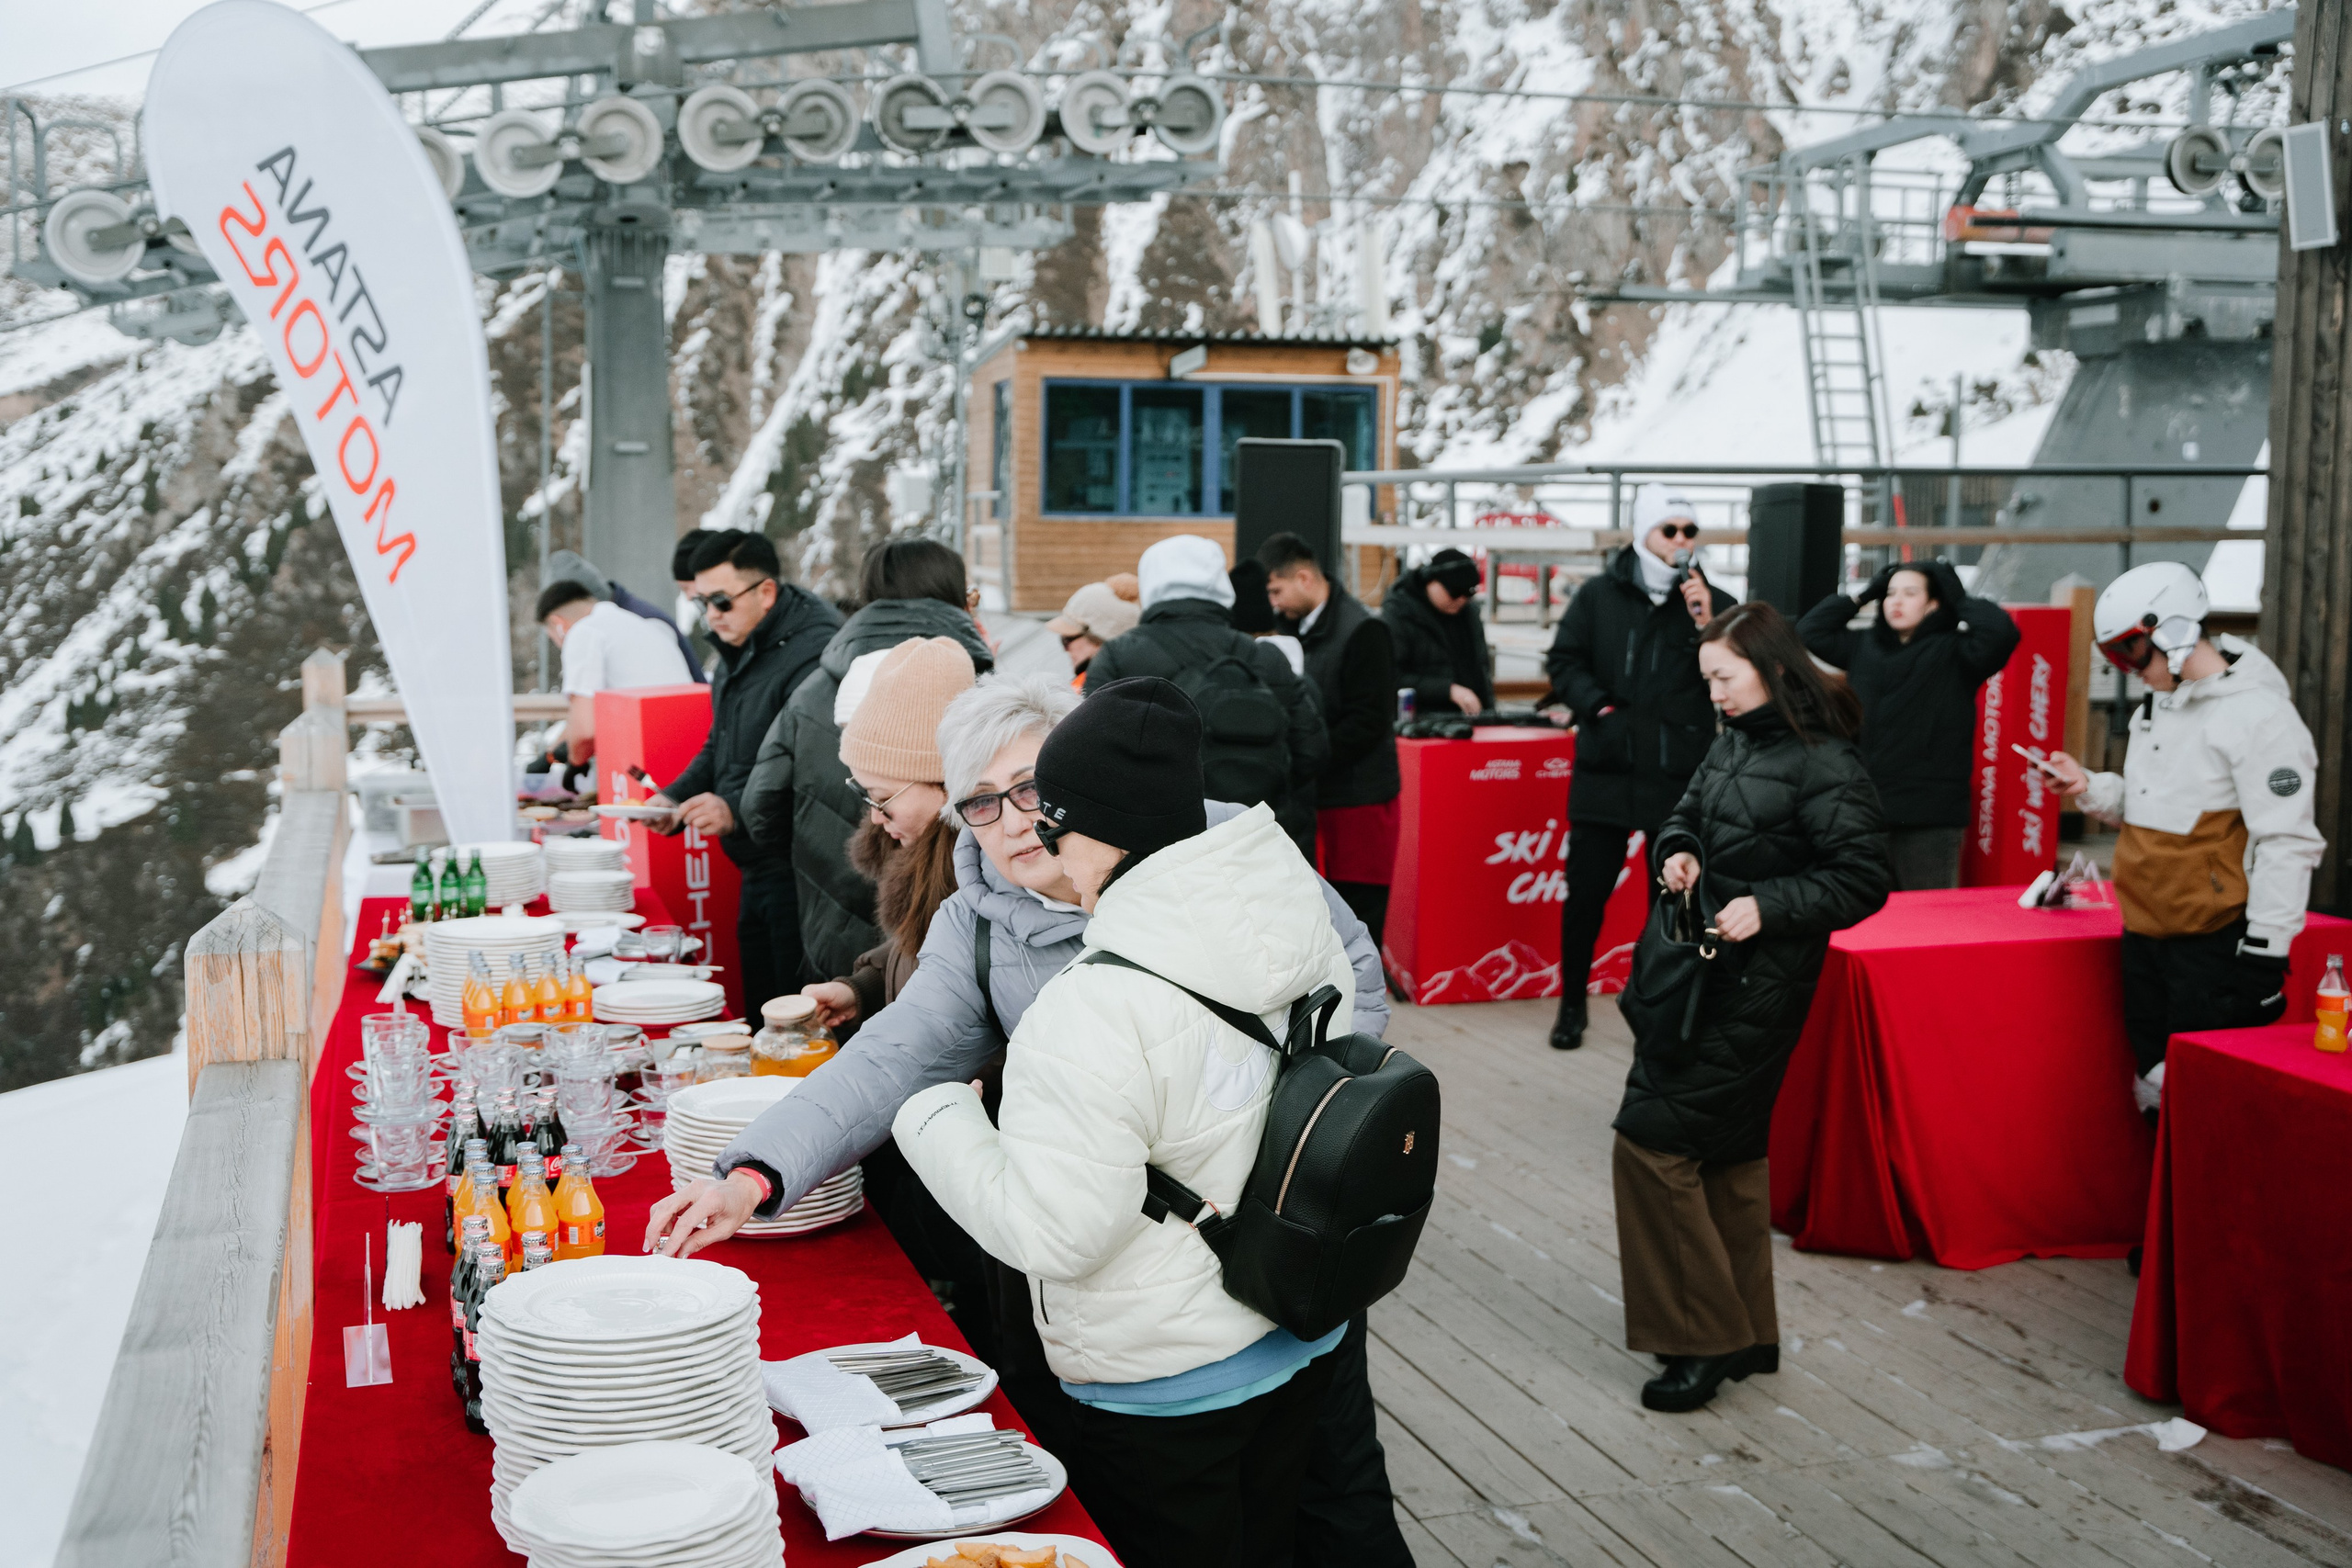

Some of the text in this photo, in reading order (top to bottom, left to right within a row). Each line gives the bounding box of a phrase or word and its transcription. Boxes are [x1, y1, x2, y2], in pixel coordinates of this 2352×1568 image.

[2029, 653, 2052, 741] CHERY
[1469, 768, 1521, 781] MOTORS
[1977, 766, 1998, 856] ASTANA
